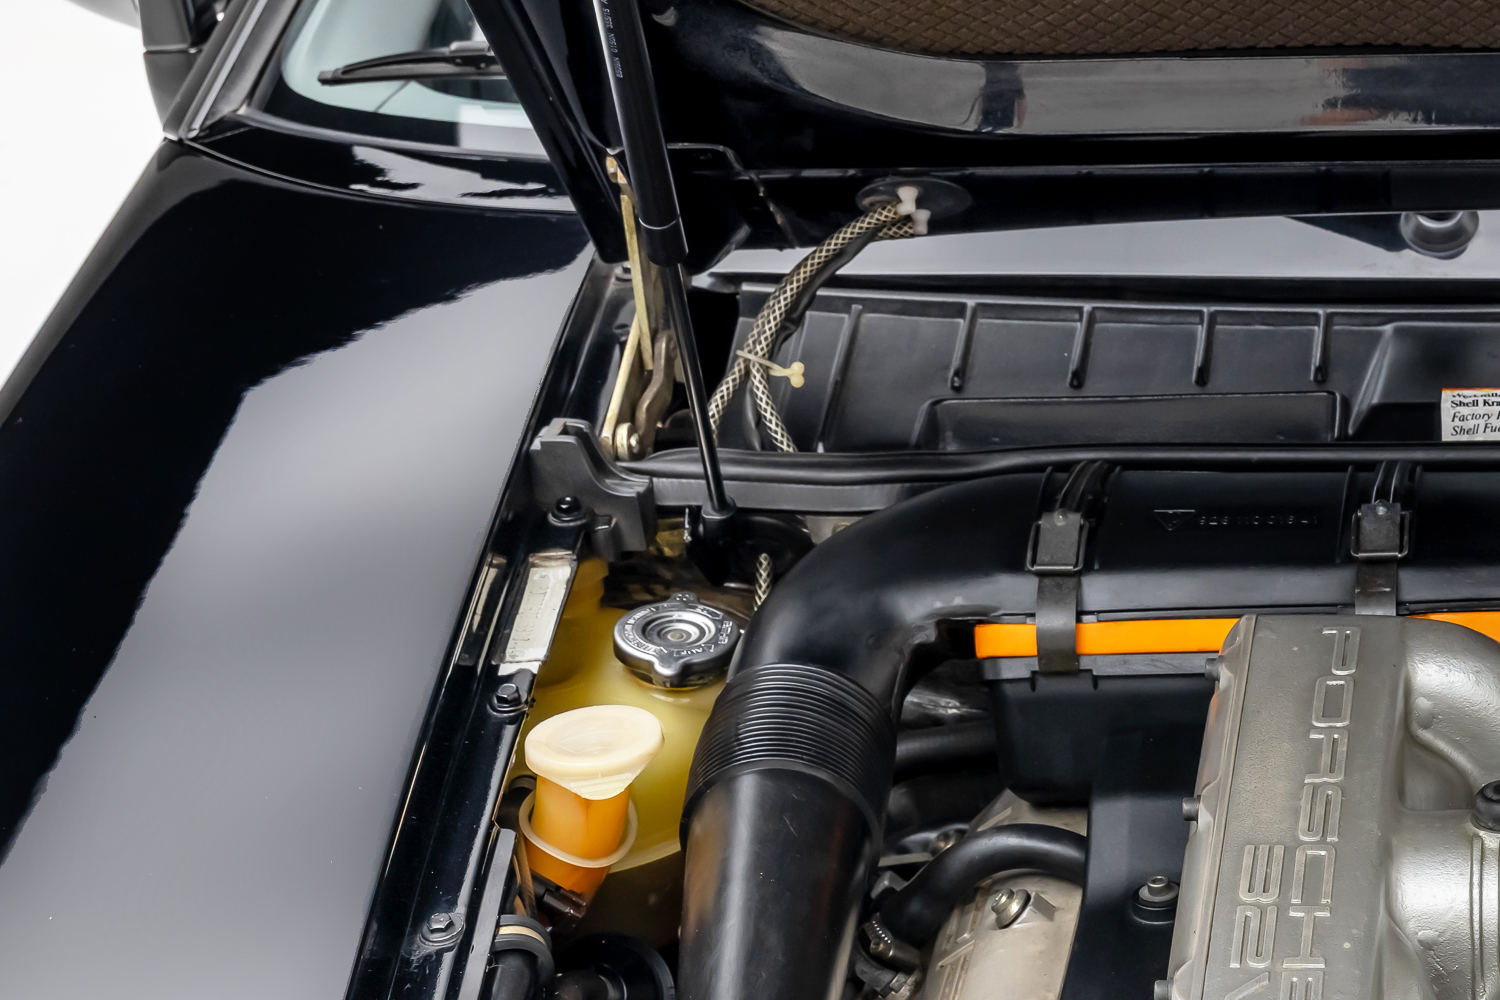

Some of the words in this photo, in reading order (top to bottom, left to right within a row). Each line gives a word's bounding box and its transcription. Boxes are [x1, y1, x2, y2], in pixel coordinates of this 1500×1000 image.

[1450, 399, 1479, 408] Shell
[1451, 411, 1493, 423] Factory
[1450, 424, 1480, 436] Shell
